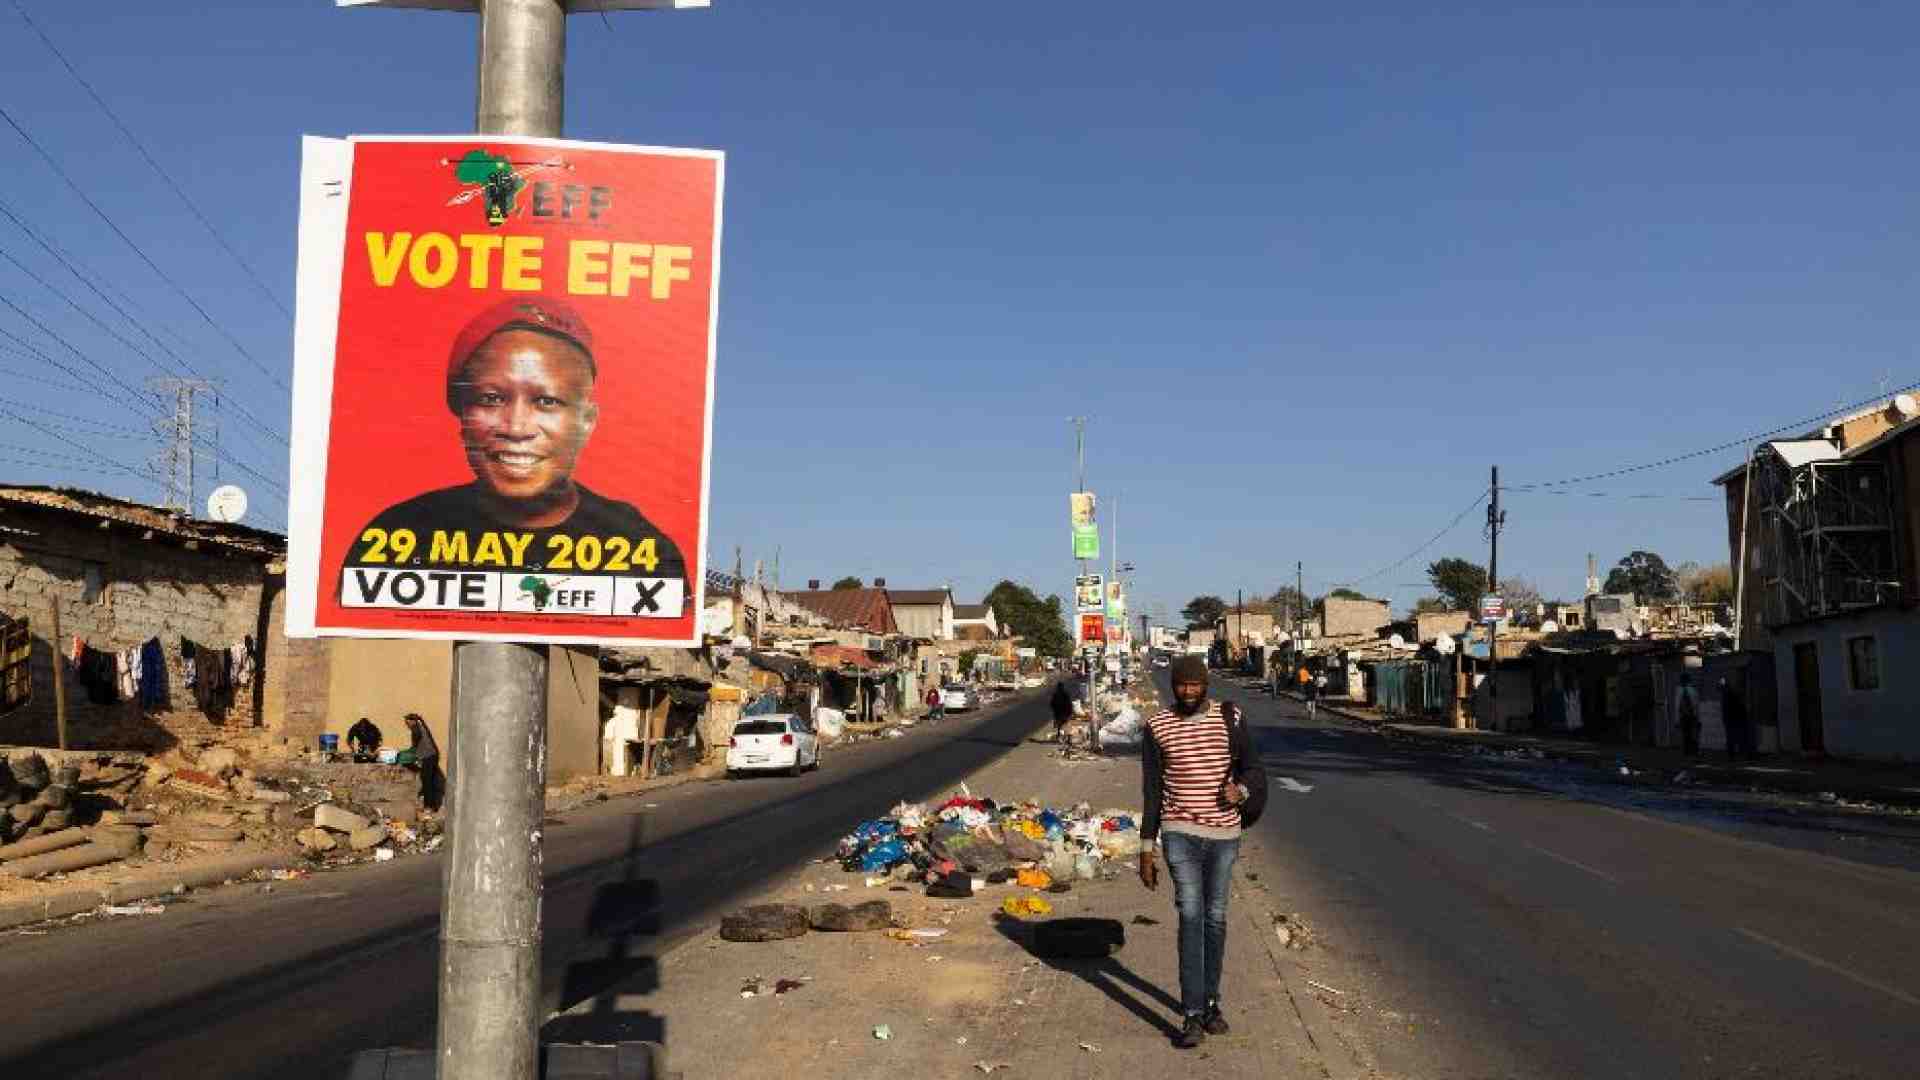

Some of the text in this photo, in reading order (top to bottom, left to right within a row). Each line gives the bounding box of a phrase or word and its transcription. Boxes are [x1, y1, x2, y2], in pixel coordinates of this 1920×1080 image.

[532, 181, 613, 220] EFF
[366, 232, 692, 299] VOTE EFF
[360, 527, 659, 572] 29 MAY 2024
[355, 568, 487, 608] VOTE
[556, 589, 597, 607] EFF
